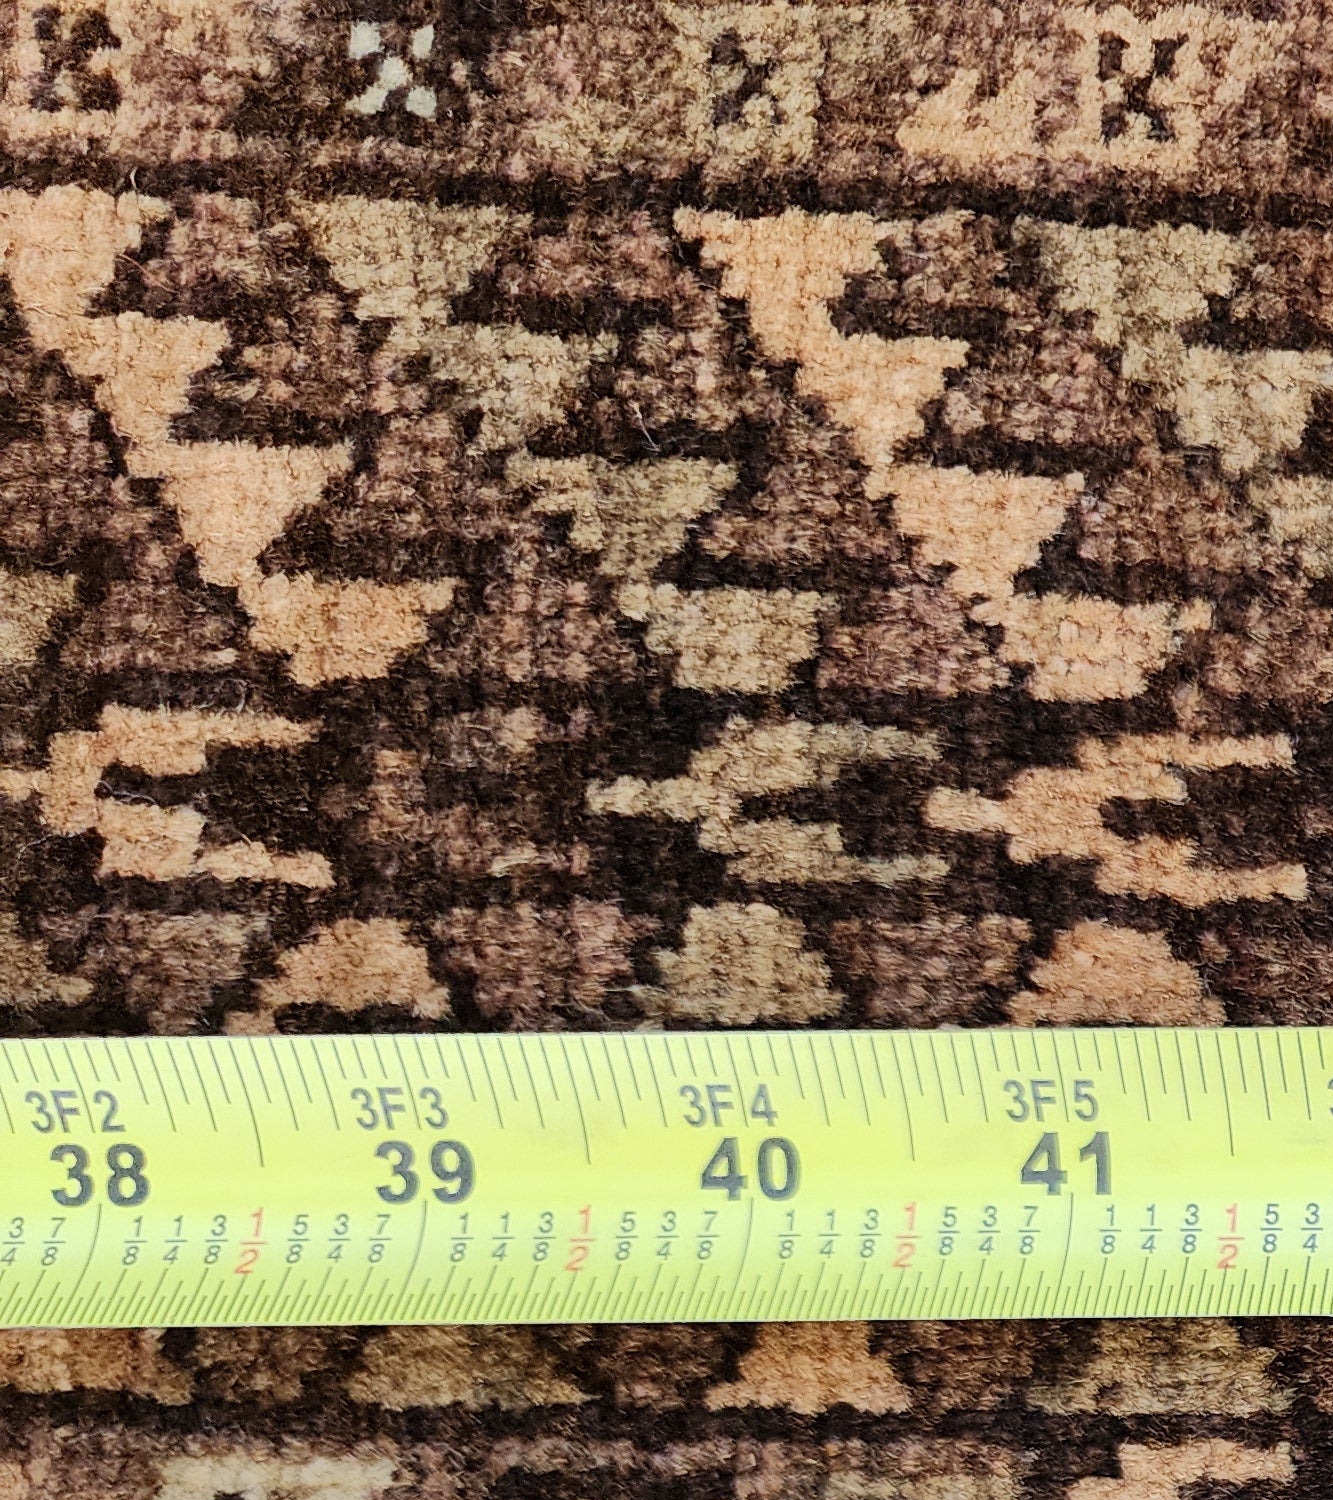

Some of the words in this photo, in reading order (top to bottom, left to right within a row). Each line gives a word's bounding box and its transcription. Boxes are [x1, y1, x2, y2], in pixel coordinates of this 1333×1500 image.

[50, 1143, 149, 1208] 38
[375, 1140, 476, 1204] 39
[701, 1135, 801, 1201] 40
[1021, 1131, 1112, 1196] 41
